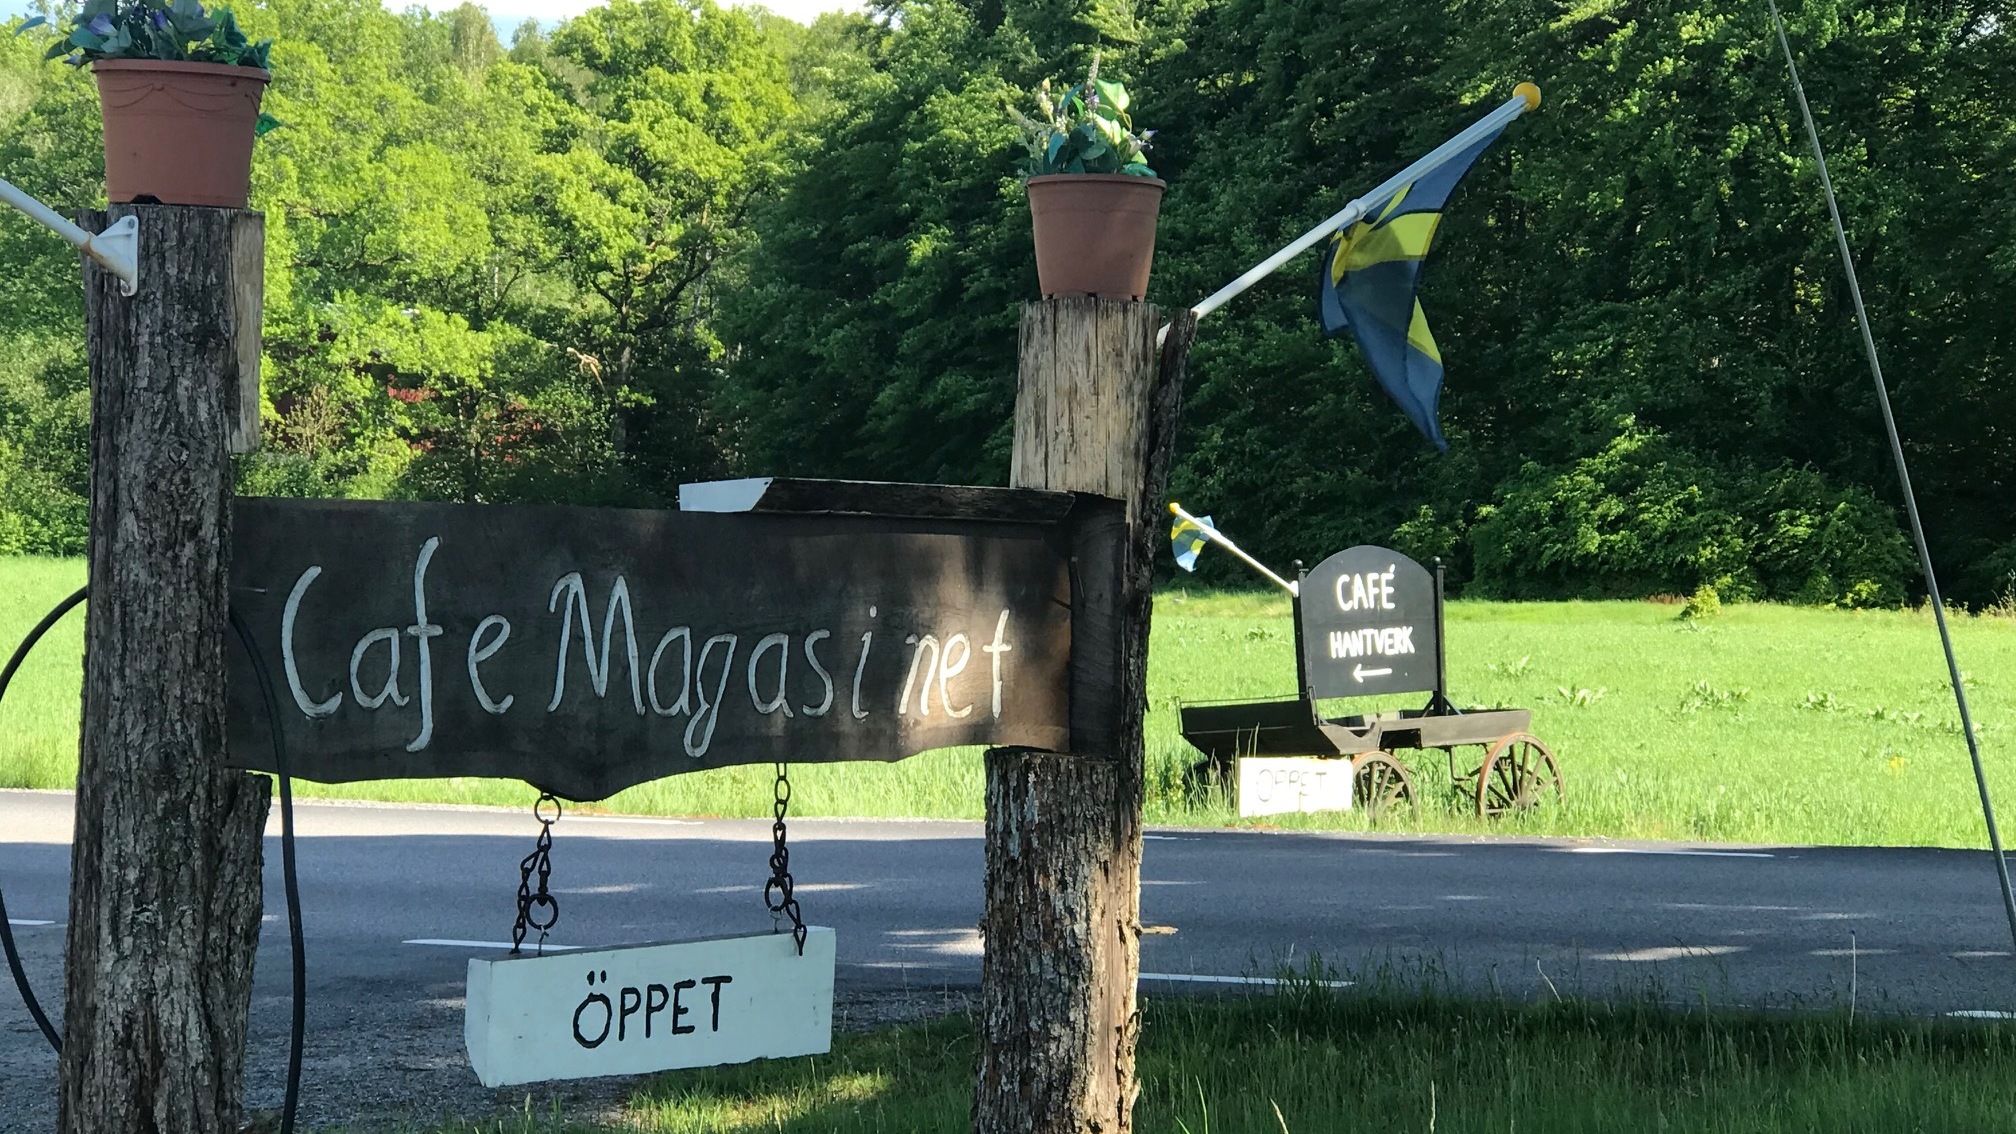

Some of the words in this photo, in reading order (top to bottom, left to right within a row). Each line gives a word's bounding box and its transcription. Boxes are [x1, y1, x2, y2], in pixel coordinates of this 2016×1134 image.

[1336, 563, 1396, 611] CAFÉ
[281, 535, 514, 753] Cafe
[548, 571, 1013, 758] Magasinet
[1330, 626, 1416, 659] HANTVERK
[572, 970, 733, 1049] ÖPPET
